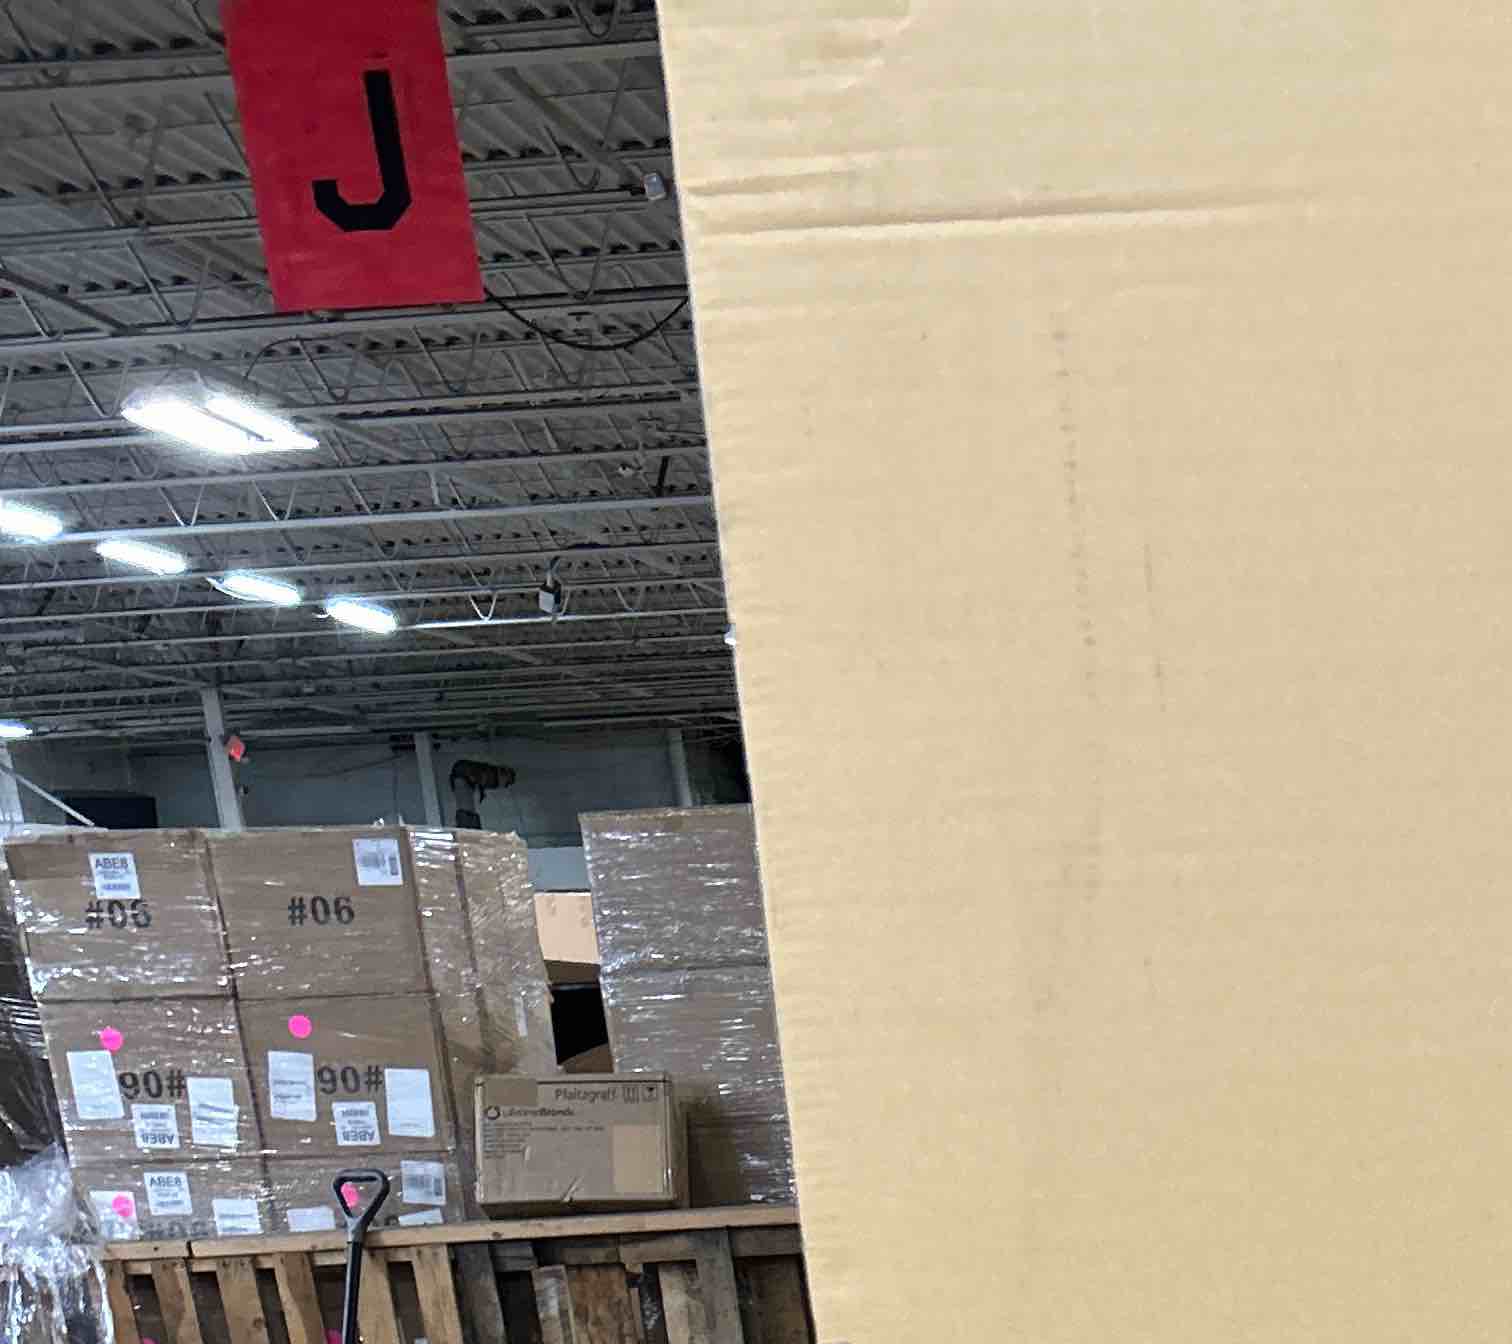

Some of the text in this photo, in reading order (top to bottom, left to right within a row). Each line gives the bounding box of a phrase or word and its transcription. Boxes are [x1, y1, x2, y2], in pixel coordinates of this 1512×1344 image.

[311, 68, 411, 232] J
[288, 895, 355, 927] #06
[118, 1070, 186, 1099] 90#
[316, 1065, 384, 1094] 90#
